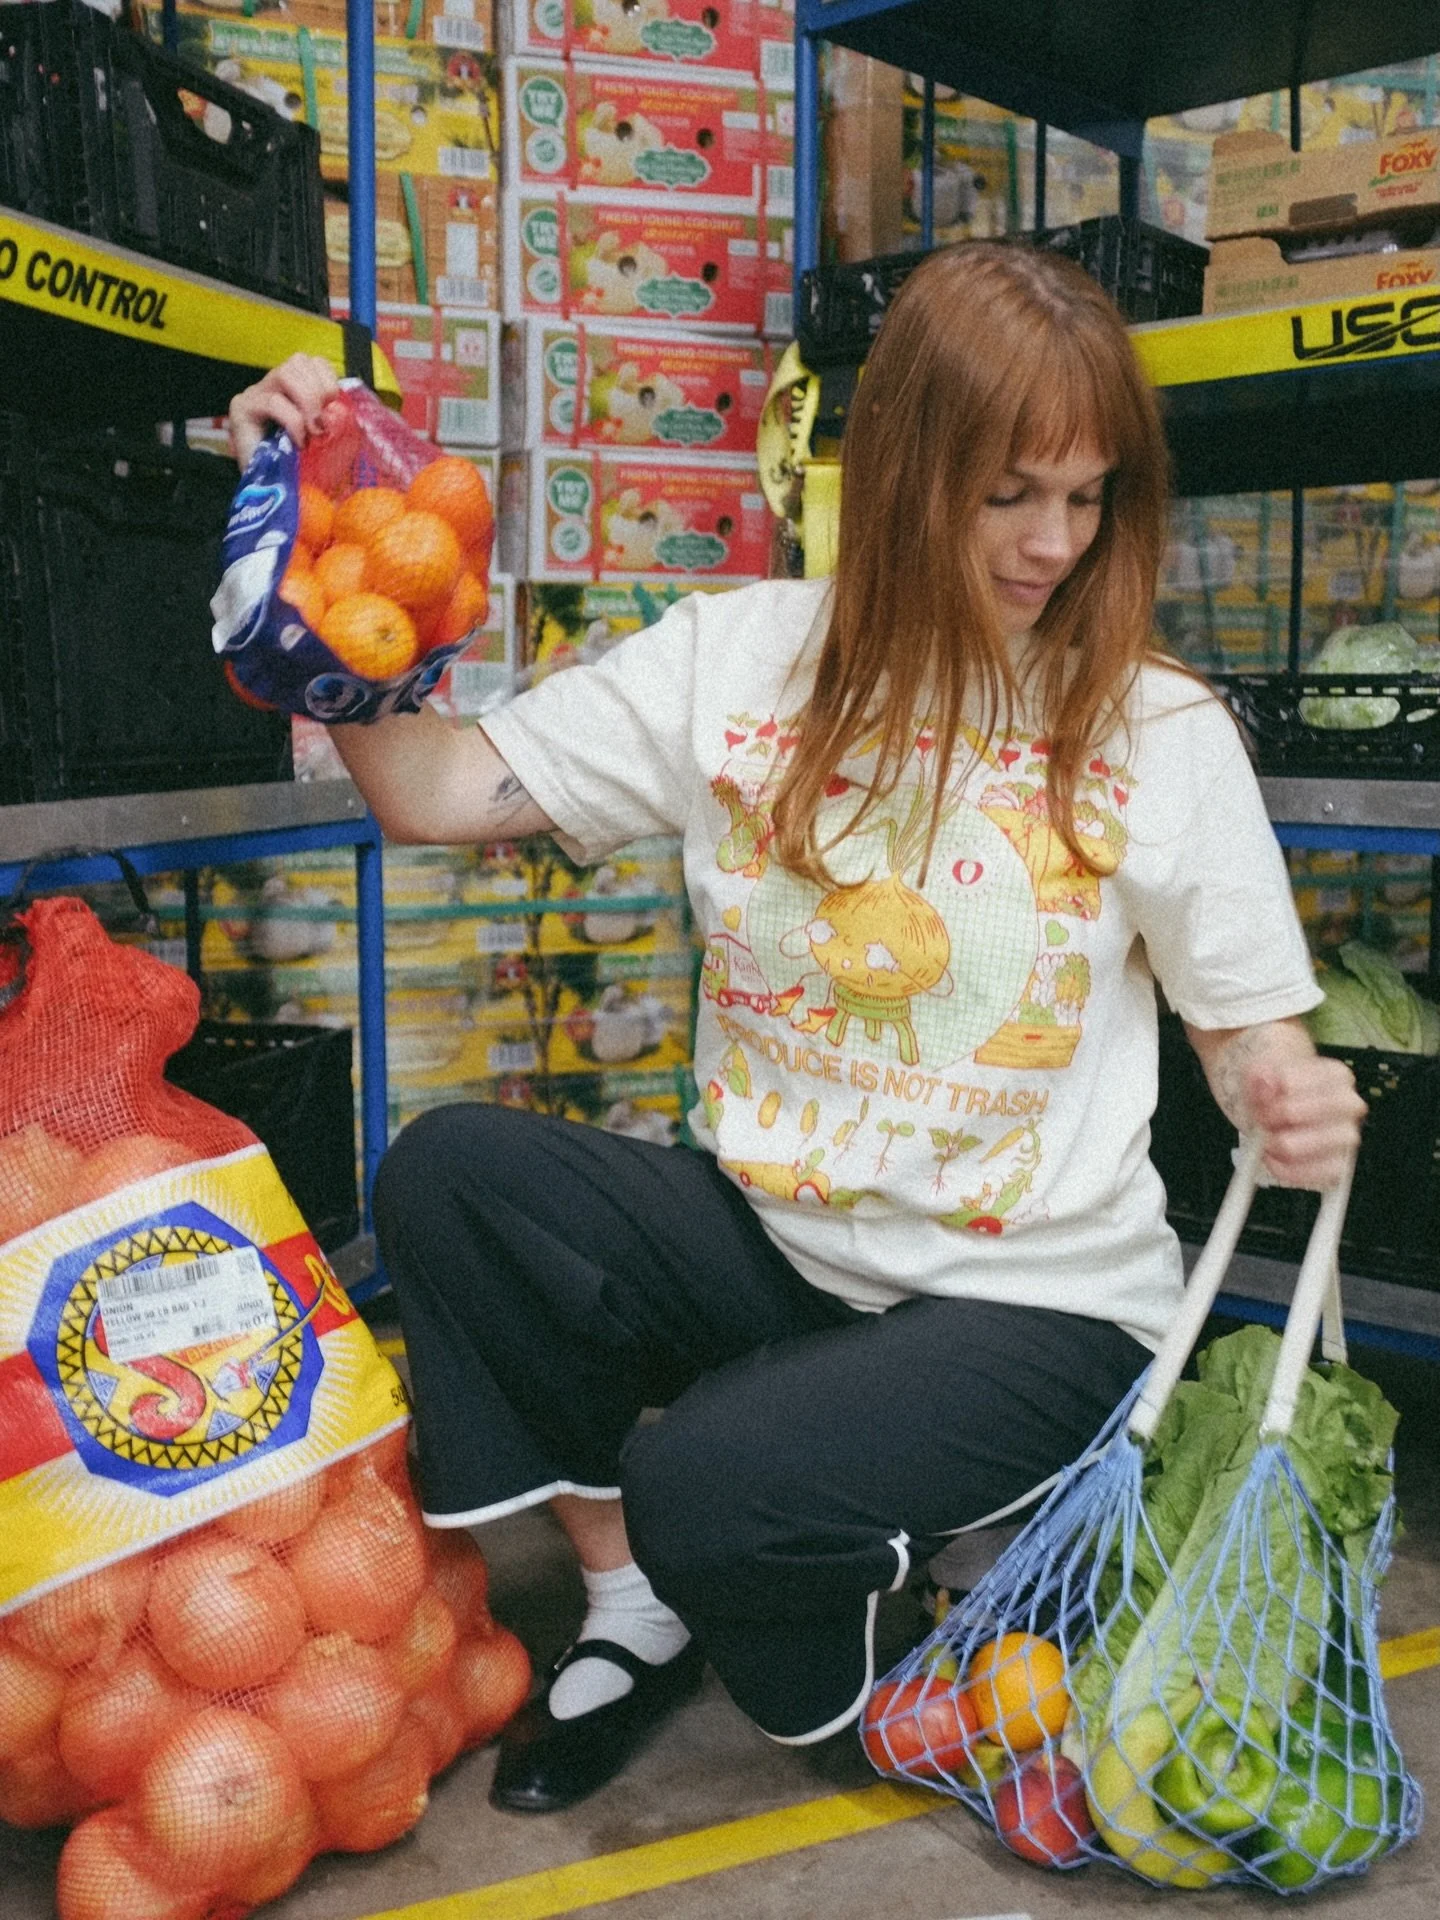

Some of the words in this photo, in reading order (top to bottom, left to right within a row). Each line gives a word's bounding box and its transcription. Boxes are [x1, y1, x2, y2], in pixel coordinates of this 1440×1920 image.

[1379, 147, 1437, 175] FOXY
[26, 250, 168, 330] CONTROL
[716, 1014, 842, 1083] PRODUCE
[850, 1059, 879, 1092] IS
[883, 1066, 942, 1106] NOT
[947, 1081, 1049, 1117] TRASH
[103, 1302, 134, 1317] ONION
[105, 1313, 142, 1327] YELLOW
